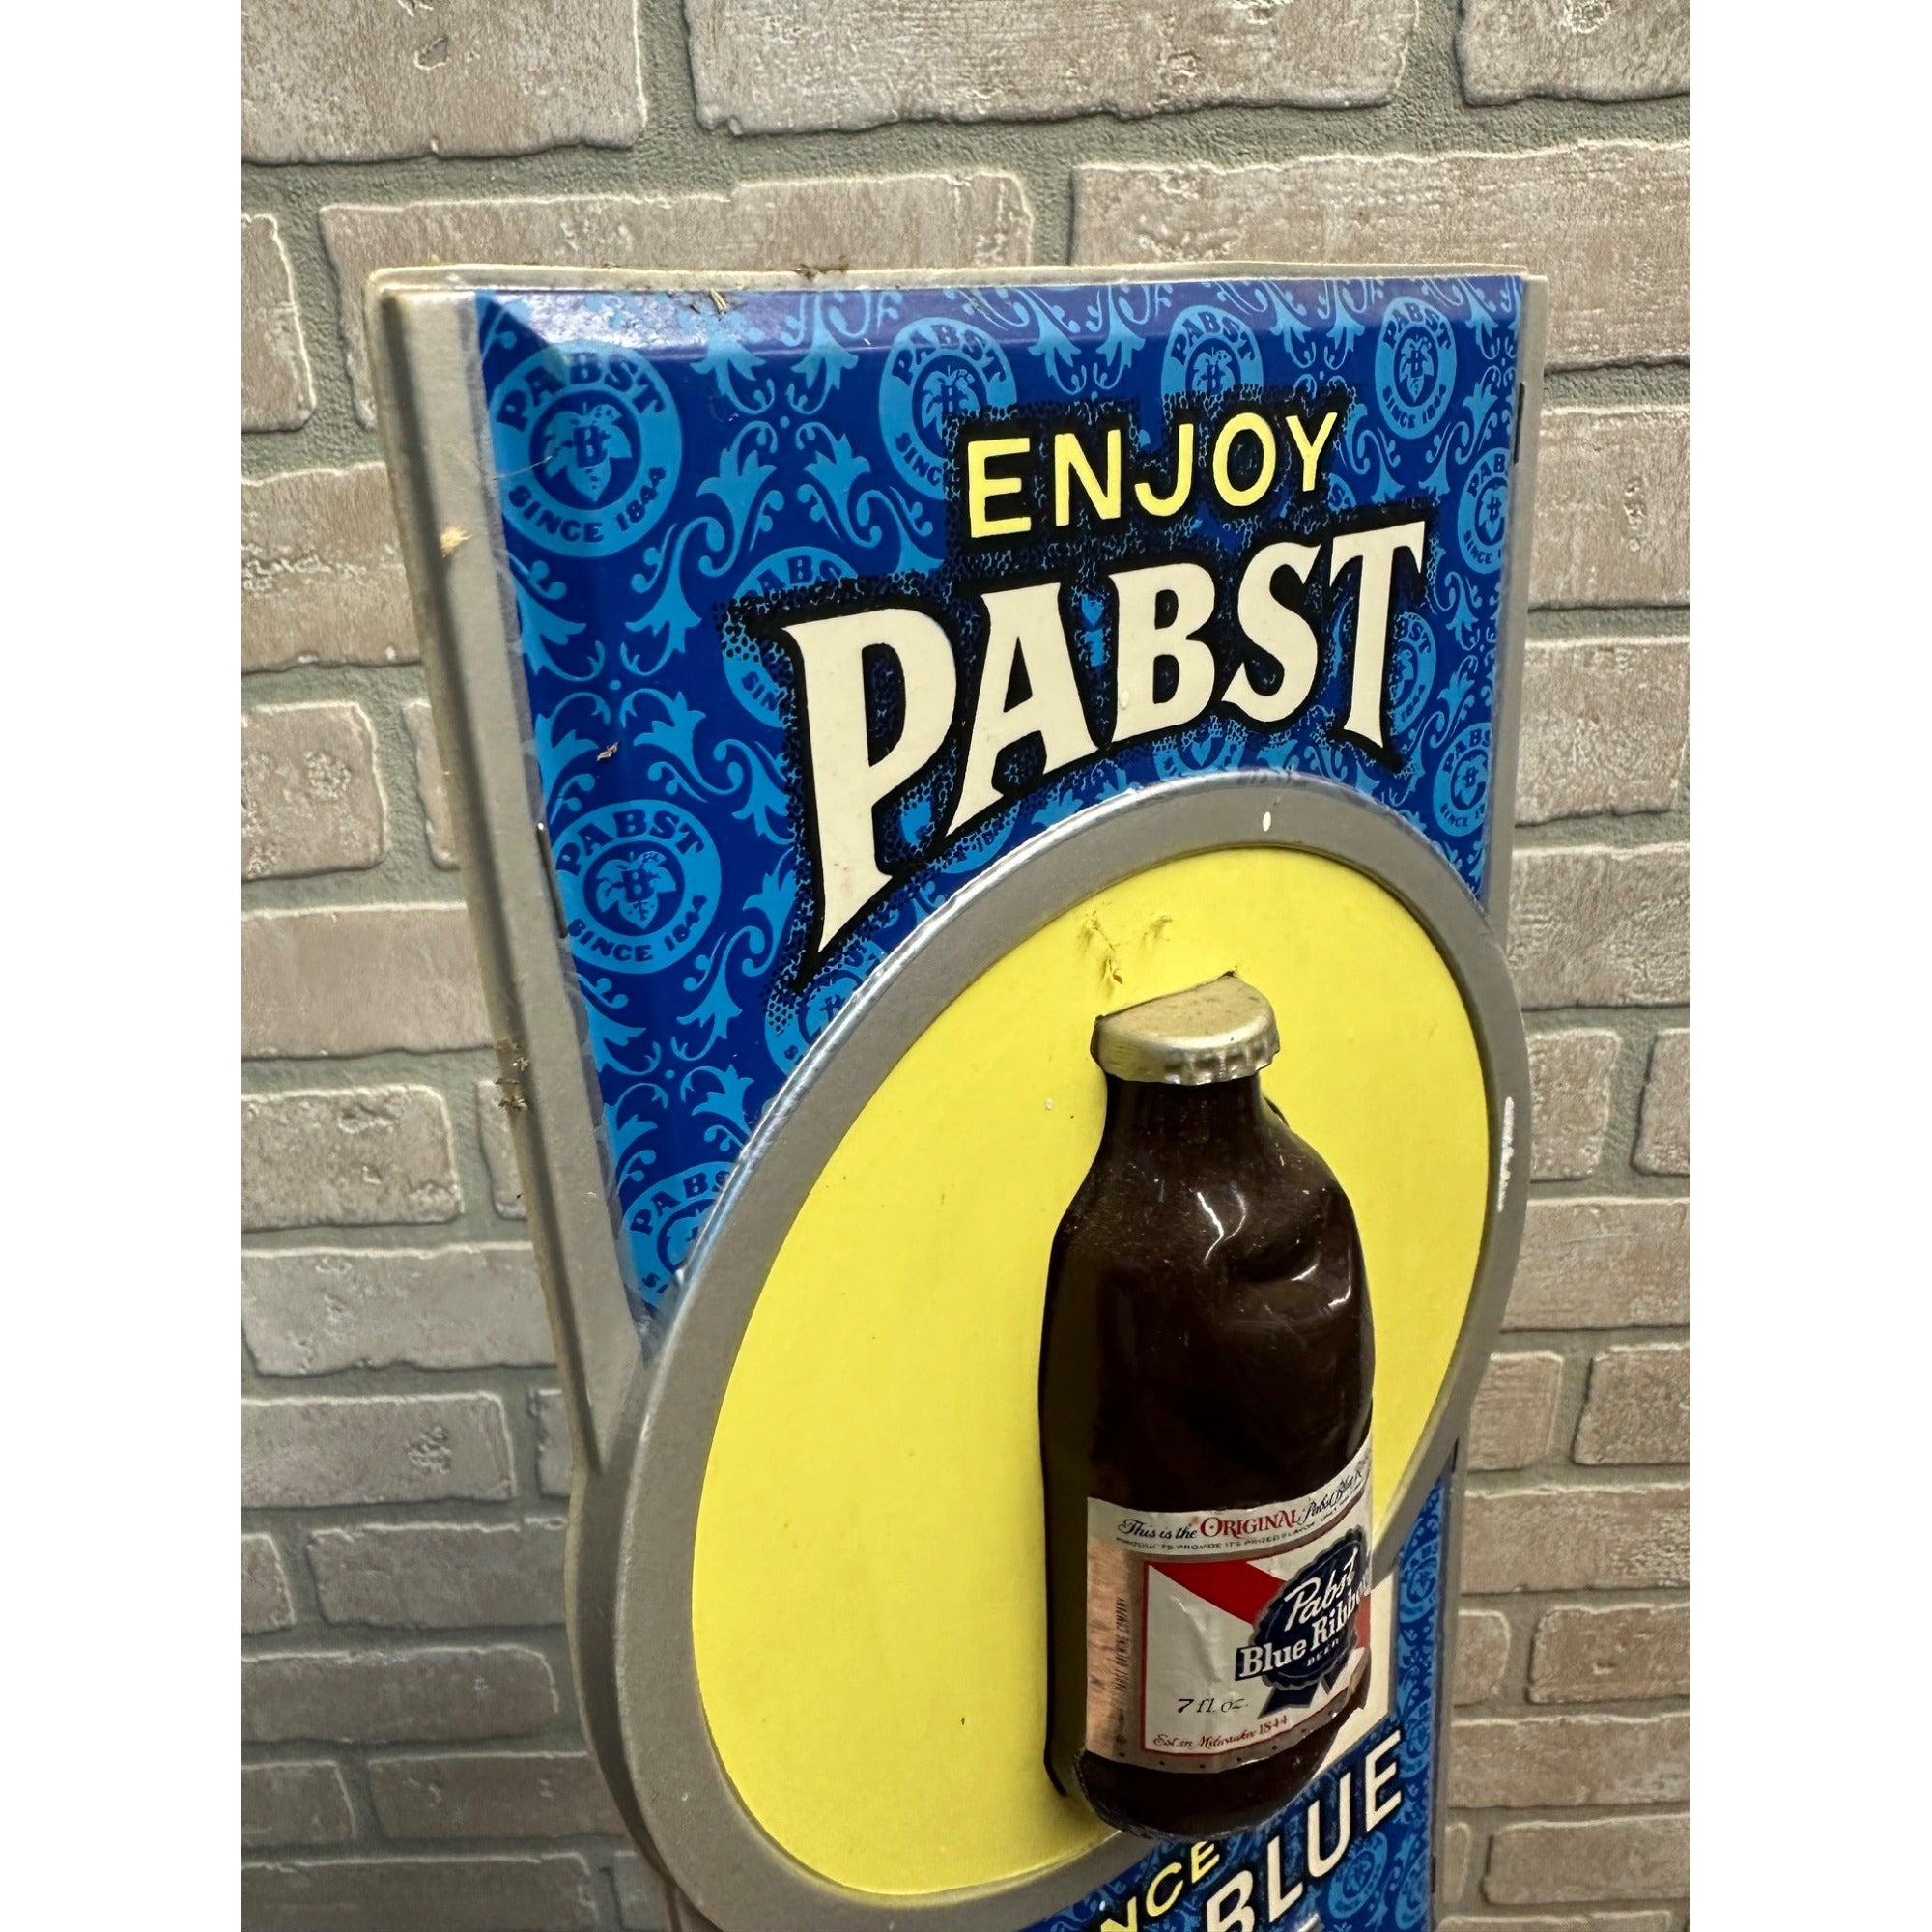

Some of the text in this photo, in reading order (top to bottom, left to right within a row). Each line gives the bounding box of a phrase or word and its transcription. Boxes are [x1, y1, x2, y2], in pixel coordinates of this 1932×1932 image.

[891, 324, 1007, 387] PABST
[1170, 311, 1256, 366] PABST
[1383, 302, 1452, 350] PABST
[496, 352, 666, 433] PABST
[895, 432, 944, 486] SINC
[967, 412, 1338, 539] ENJOY
[1466, 452, 1506, 498] PAB
[508, 467, 667, 544] SINCE 1844
[756, 555, 842, 594] ABS
[741, 671, 780, 712] SIN
[782, 520, 1427, 954] PABST
[1442, 728, 1491, 774] PABS
[555, 809, 705, 877] PABST
[568, 895, 708, 963] SINCE 1844
[630, 1170, 731, 1236] PABS
[1117, 1518, 1156, 1539] This
[1159, 1526, 1172, 1540] is
[1175, 1523, 1198, 1540] the
[1200, 1509, 1298, 1540] ORIGINAL
[1283, 1546, 1359, 1633] Pabst
[1238, 1639, 1307, 1678] Blue
[1309, 1582, 1365, 1652] Ribb
[1178, 1698, 1195, 1714] 7
[1259, 1715, 1288, 1735] 1844
[1206, 1730, 1403, 1932] BLUE
